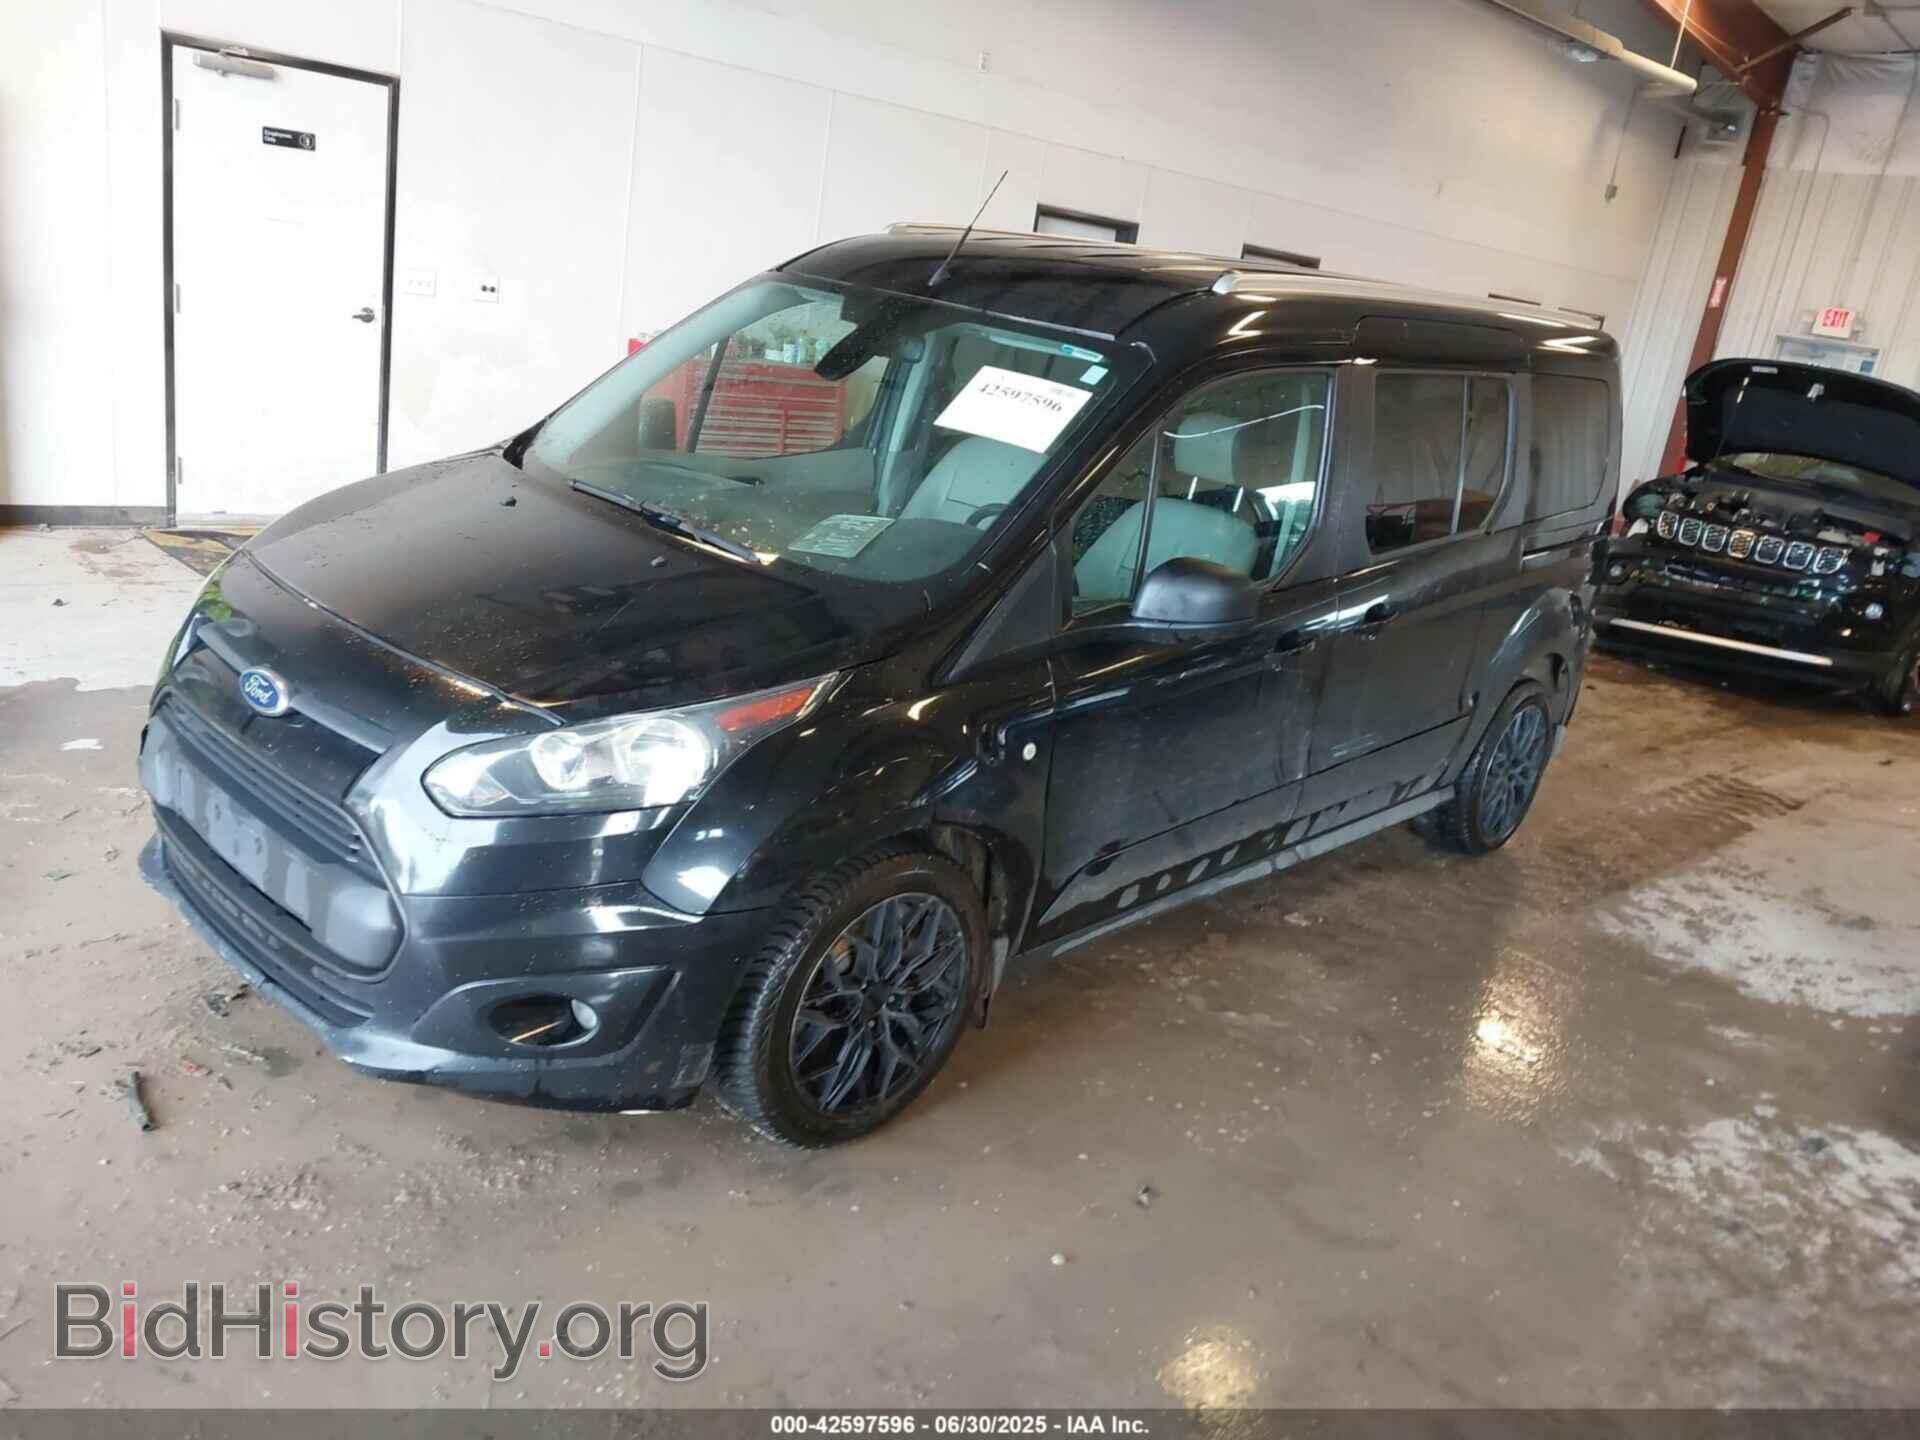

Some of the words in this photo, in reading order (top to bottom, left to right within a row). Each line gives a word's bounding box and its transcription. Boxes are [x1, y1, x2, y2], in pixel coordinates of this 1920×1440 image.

[1822, 308, 1850, 328] EXIT
[978, 382, 1064, 412] 42597596
[244, 674, 275, 704] Ford
